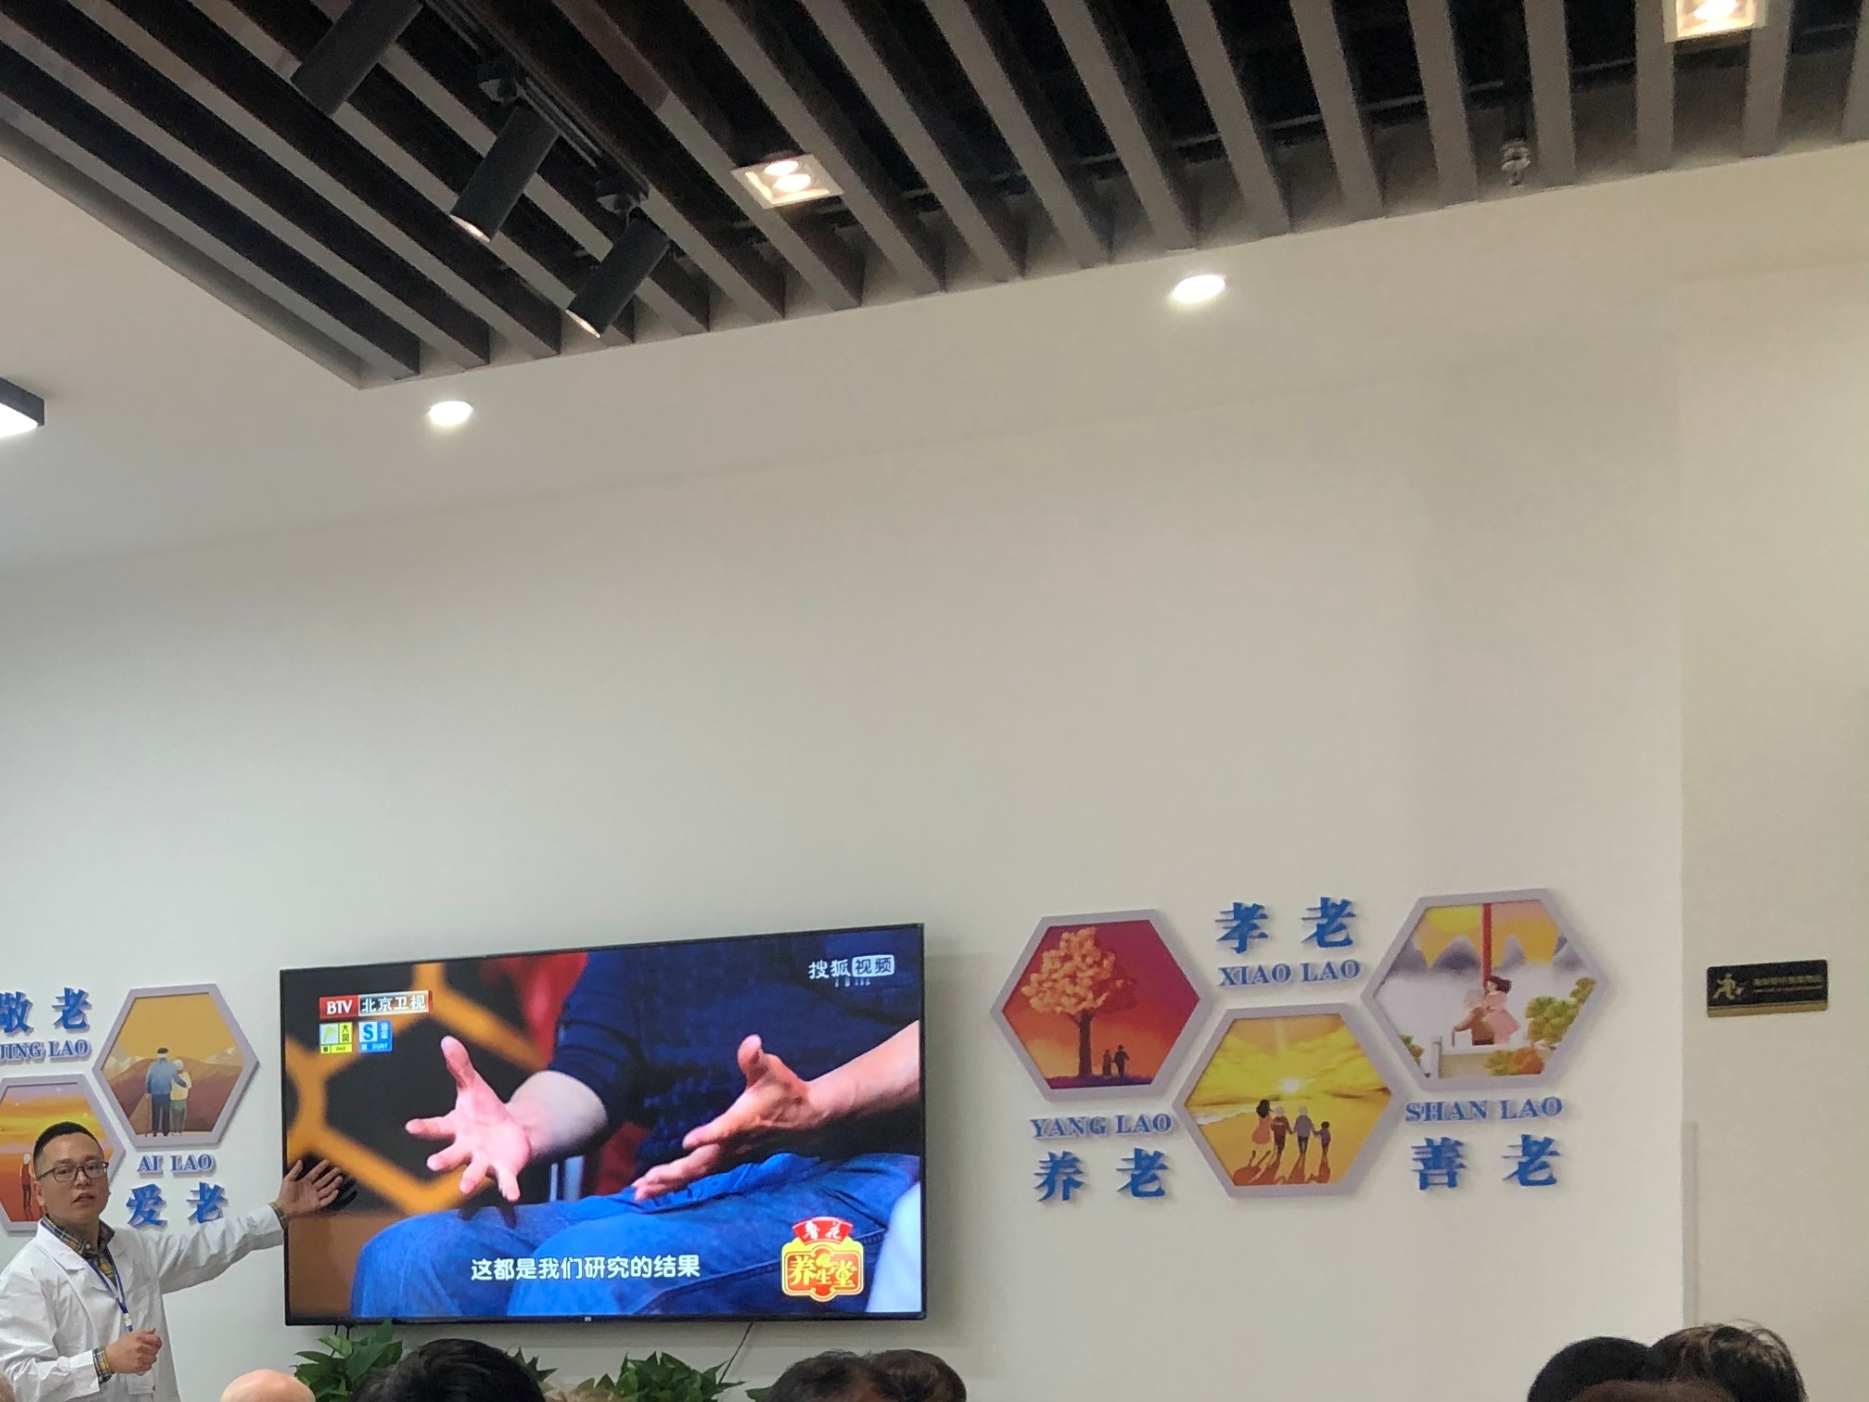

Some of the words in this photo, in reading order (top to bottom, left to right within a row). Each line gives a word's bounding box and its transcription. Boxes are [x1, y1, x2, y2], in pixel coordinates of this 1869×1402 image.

[1214, 897, 1357, 954] 孝老
[1218, 963, 1292, 987] XIAO
[1301, 959, 1361, 983] LAO
[326, 1000, 352, 1015] BTV
[361, 994, 426, 1012] 北京卫视
[48, 1039, 91, 1059] LAO
[1405, 1100, 1488, 1122] SHAN
[1500, 1096, 1563, 1120] LAO
[1030, 1116, 1107, 1138] YANG
[1115, 1113, 1172, 1134] LAO
[137, 1154, 163, 1173] AI
[171, 1153, 214, 1173] LAO
[1034, 1148, 1169, 1201] 养老
[1411, 1134, 1561, 1190] 善老
[126, 1182, 229, 1226] 爱老
[470, 1253, 702, 1281] 这都是我们研究的结果
[788, 1253, 858, 1288] 养生堂
